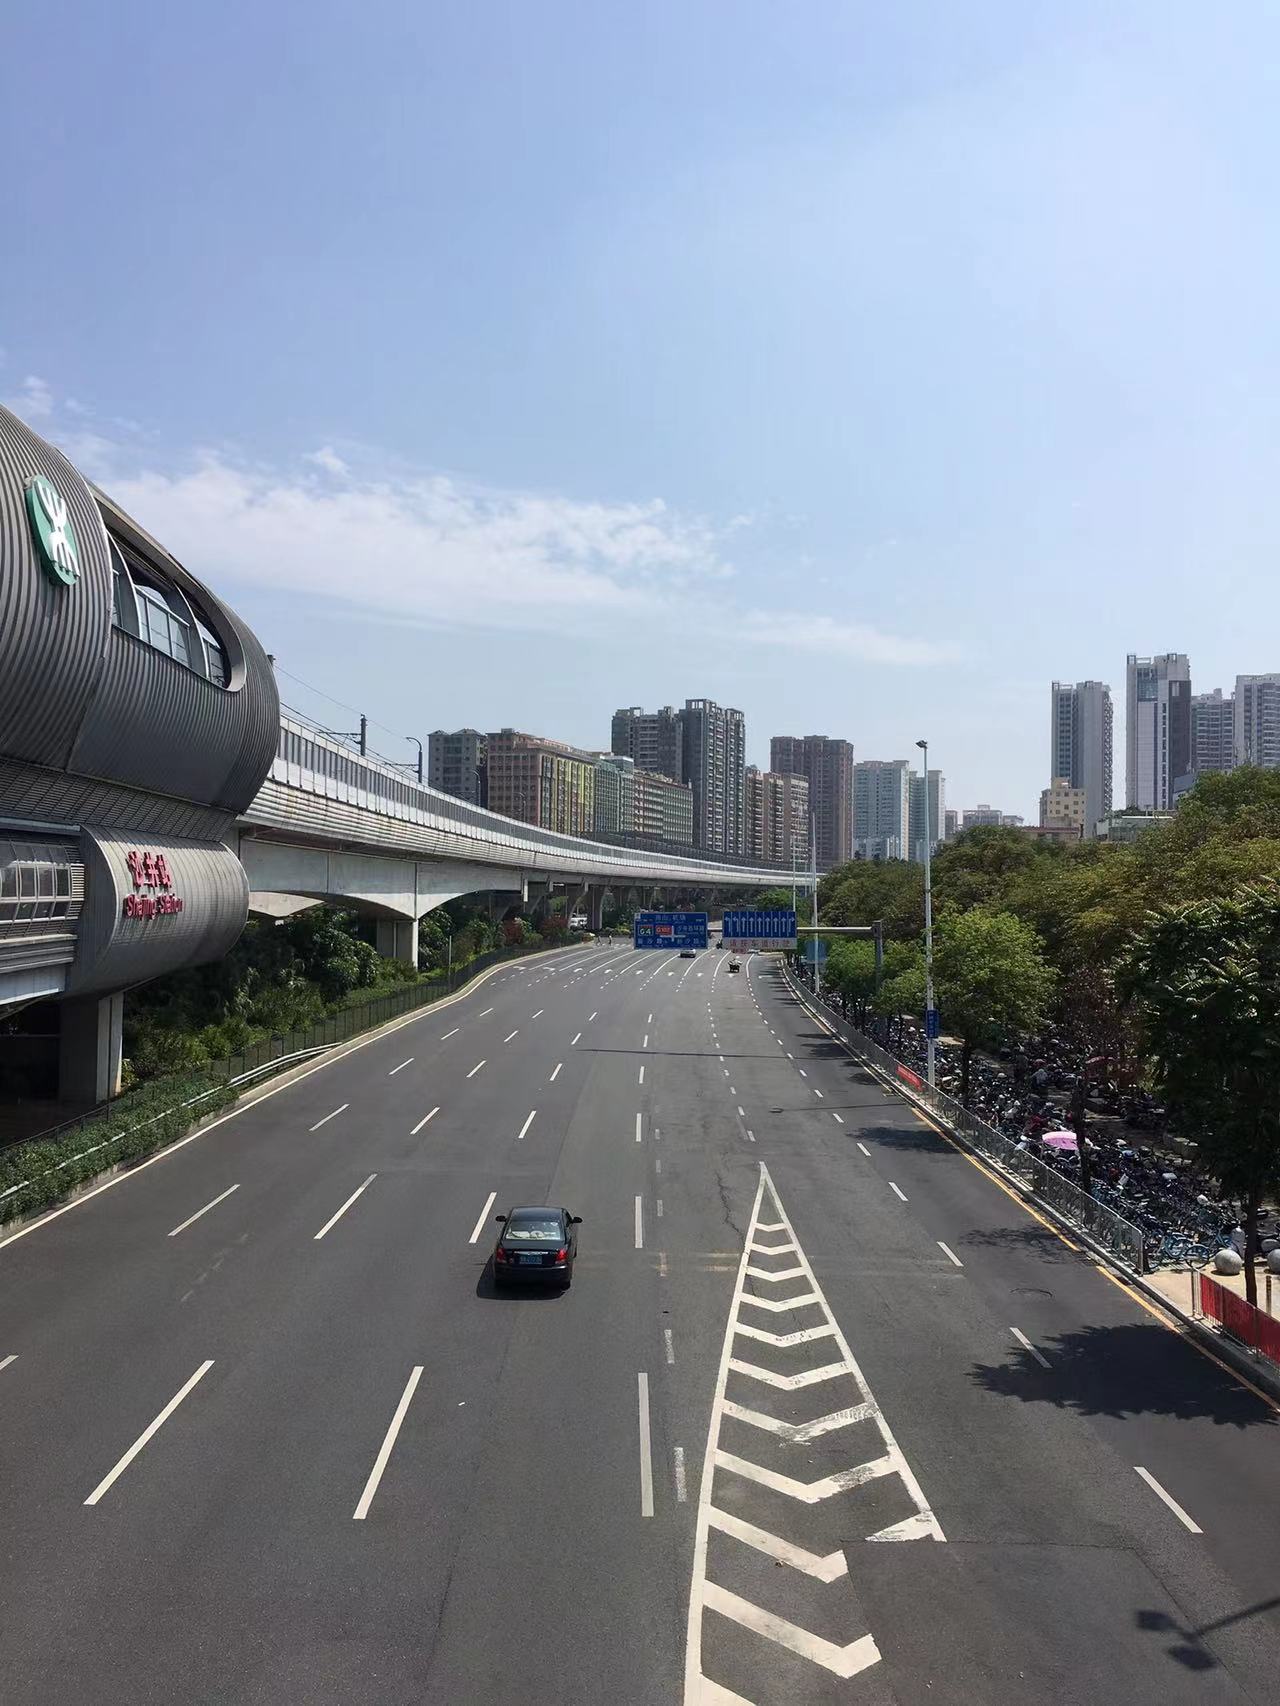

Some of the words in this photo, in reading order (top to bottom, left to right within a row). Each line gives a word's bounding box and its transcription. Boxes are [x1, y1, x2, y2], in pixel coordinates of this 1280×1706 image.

[127, 851, 172, 888] 沙井站
[125, 894, 157, 919] Shajing
[158, 893, 184, 914] Station
